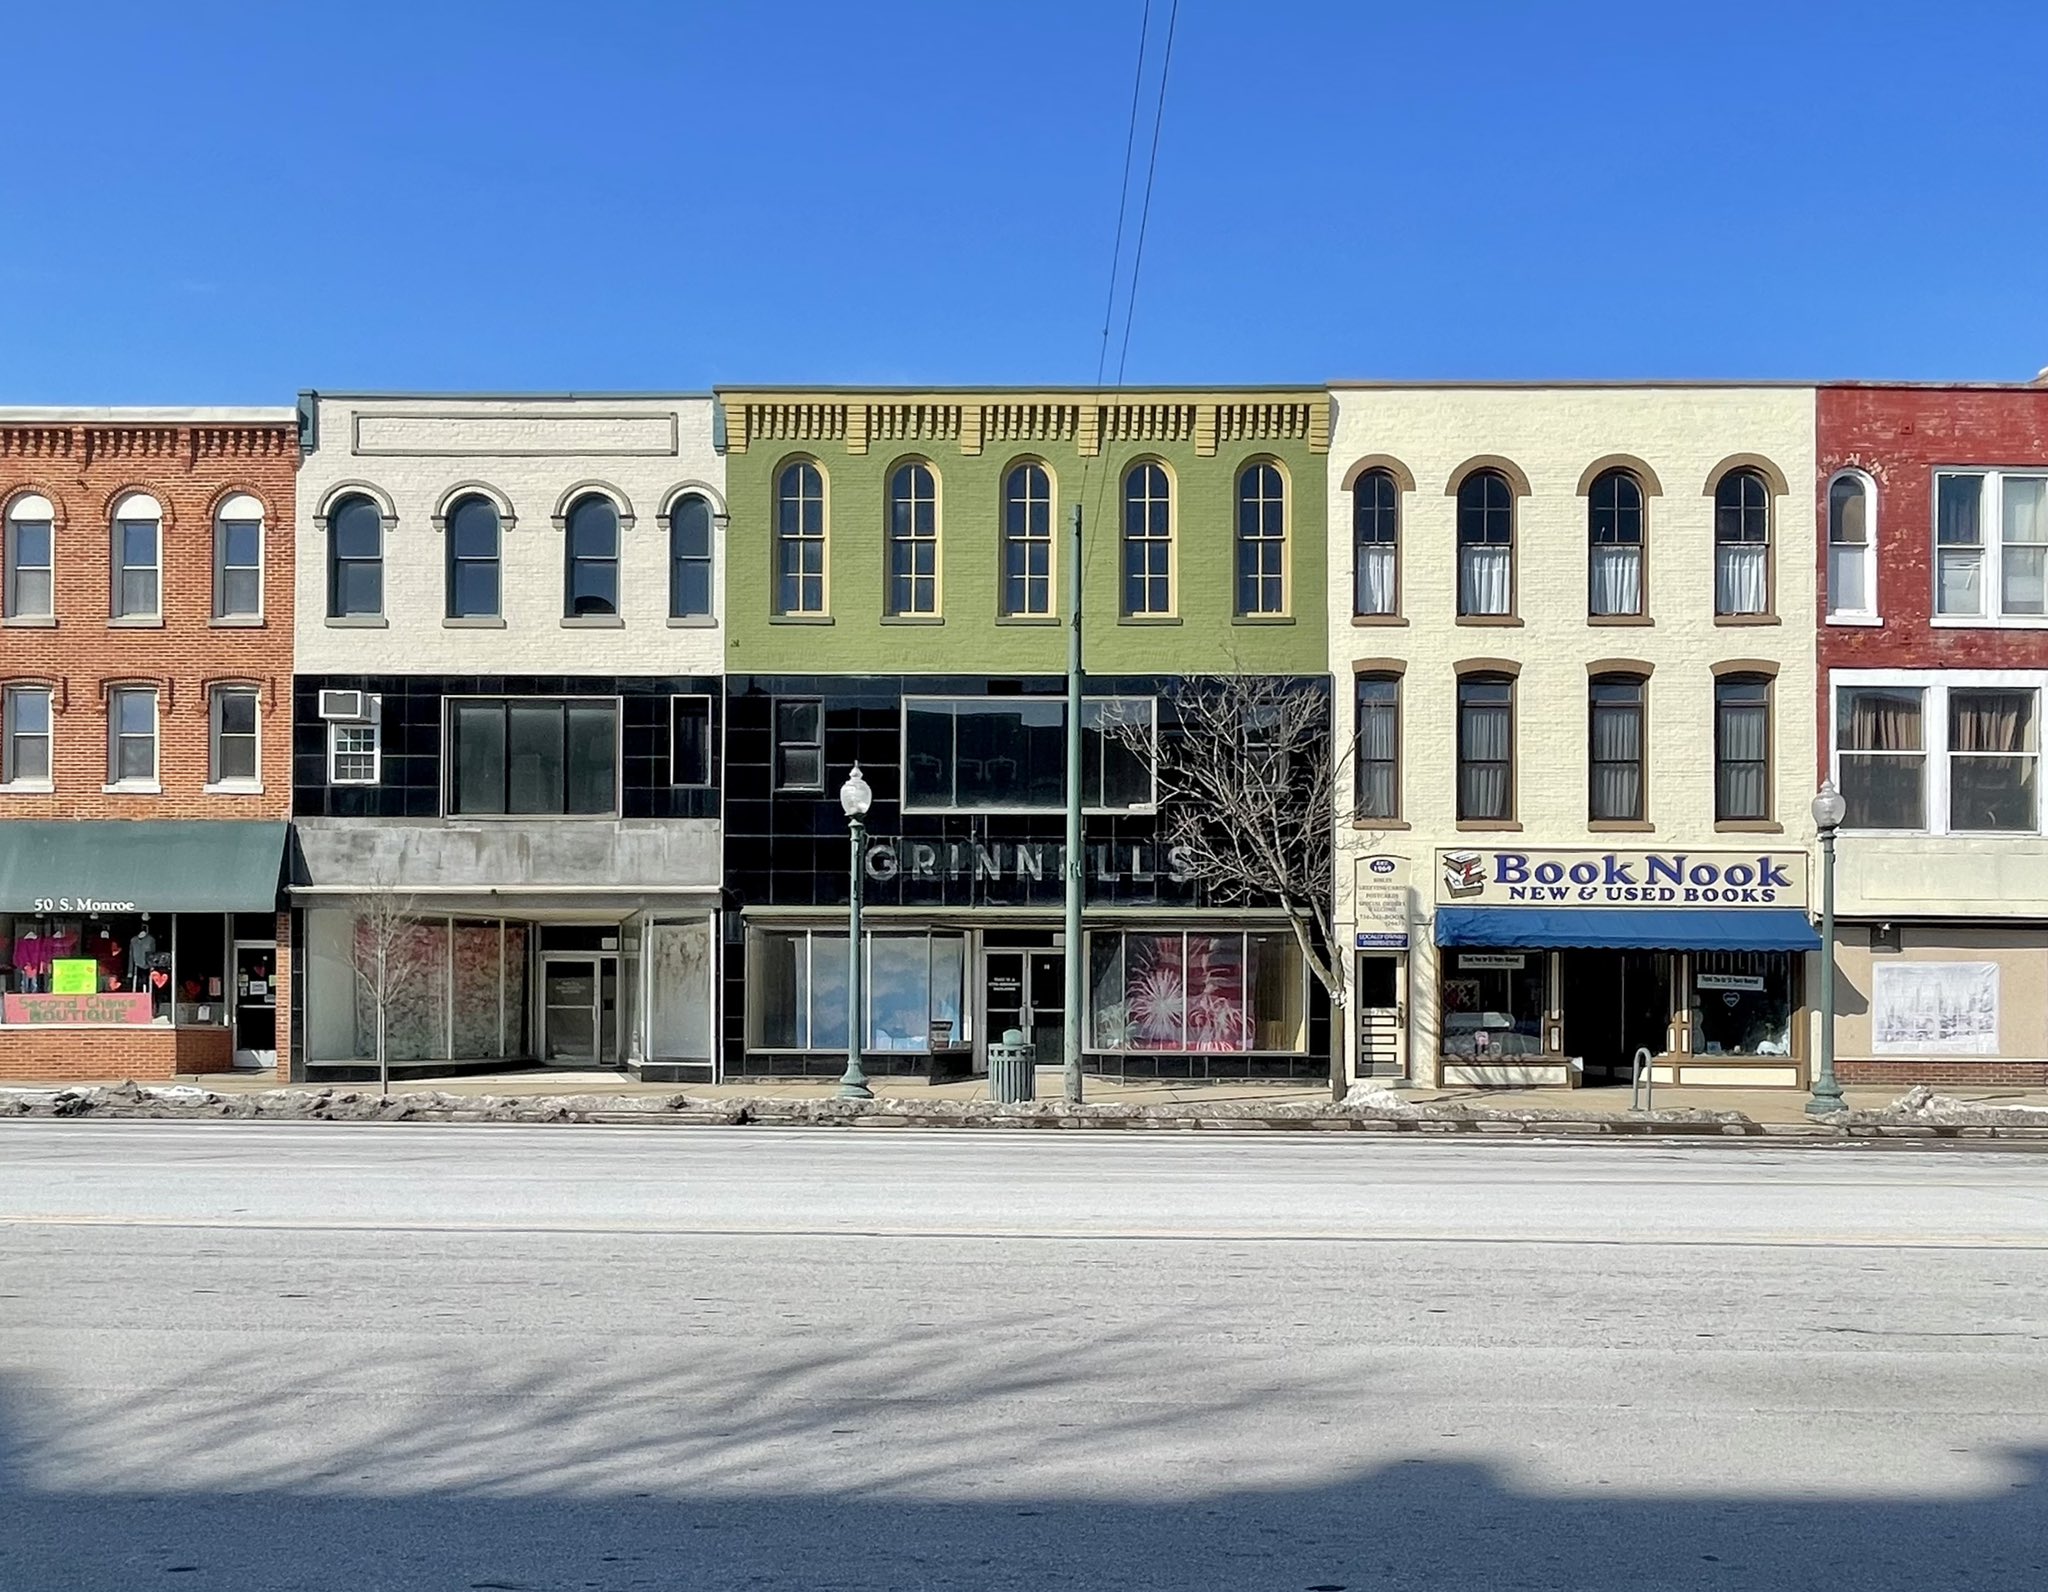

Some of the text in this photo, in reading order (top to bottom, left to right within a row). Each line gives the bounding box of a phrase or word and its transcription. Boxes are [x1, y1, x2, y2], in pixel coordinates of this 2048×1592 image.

[1493, 853, 1794, 887] Book Nook
[1508, 886, 1776, 903] NEW & USED BOOKS
[34, 897, 136, 912] 50 S. Monroe
[19, 996, 77, 1009] Second
